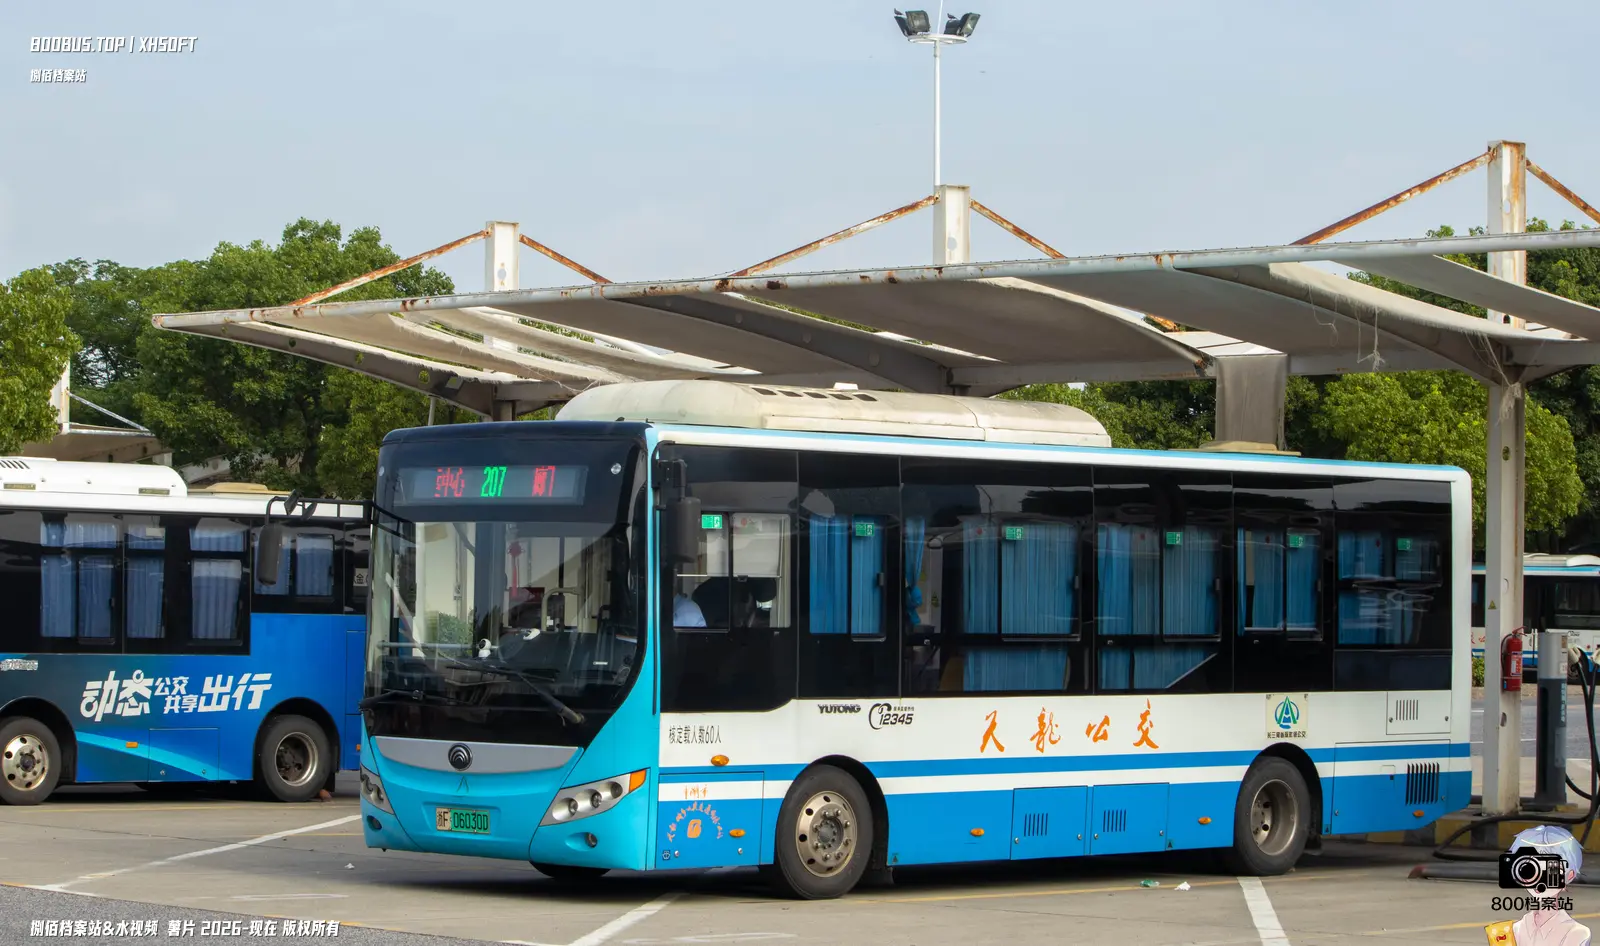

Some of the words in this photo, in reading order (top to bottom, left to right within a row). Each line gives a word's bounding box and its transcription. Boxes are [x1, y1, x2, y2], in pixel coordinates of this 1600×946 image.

[480, 466, 507, 497] 207
[80, 669, 154, 722] 动态
[197, 672, 273, 713] 出行
[817, 703, 862, 714] YUTONG
[879, 713, 914, 726] 12345
[668, 725, 722, 745] 核定载人数60人
